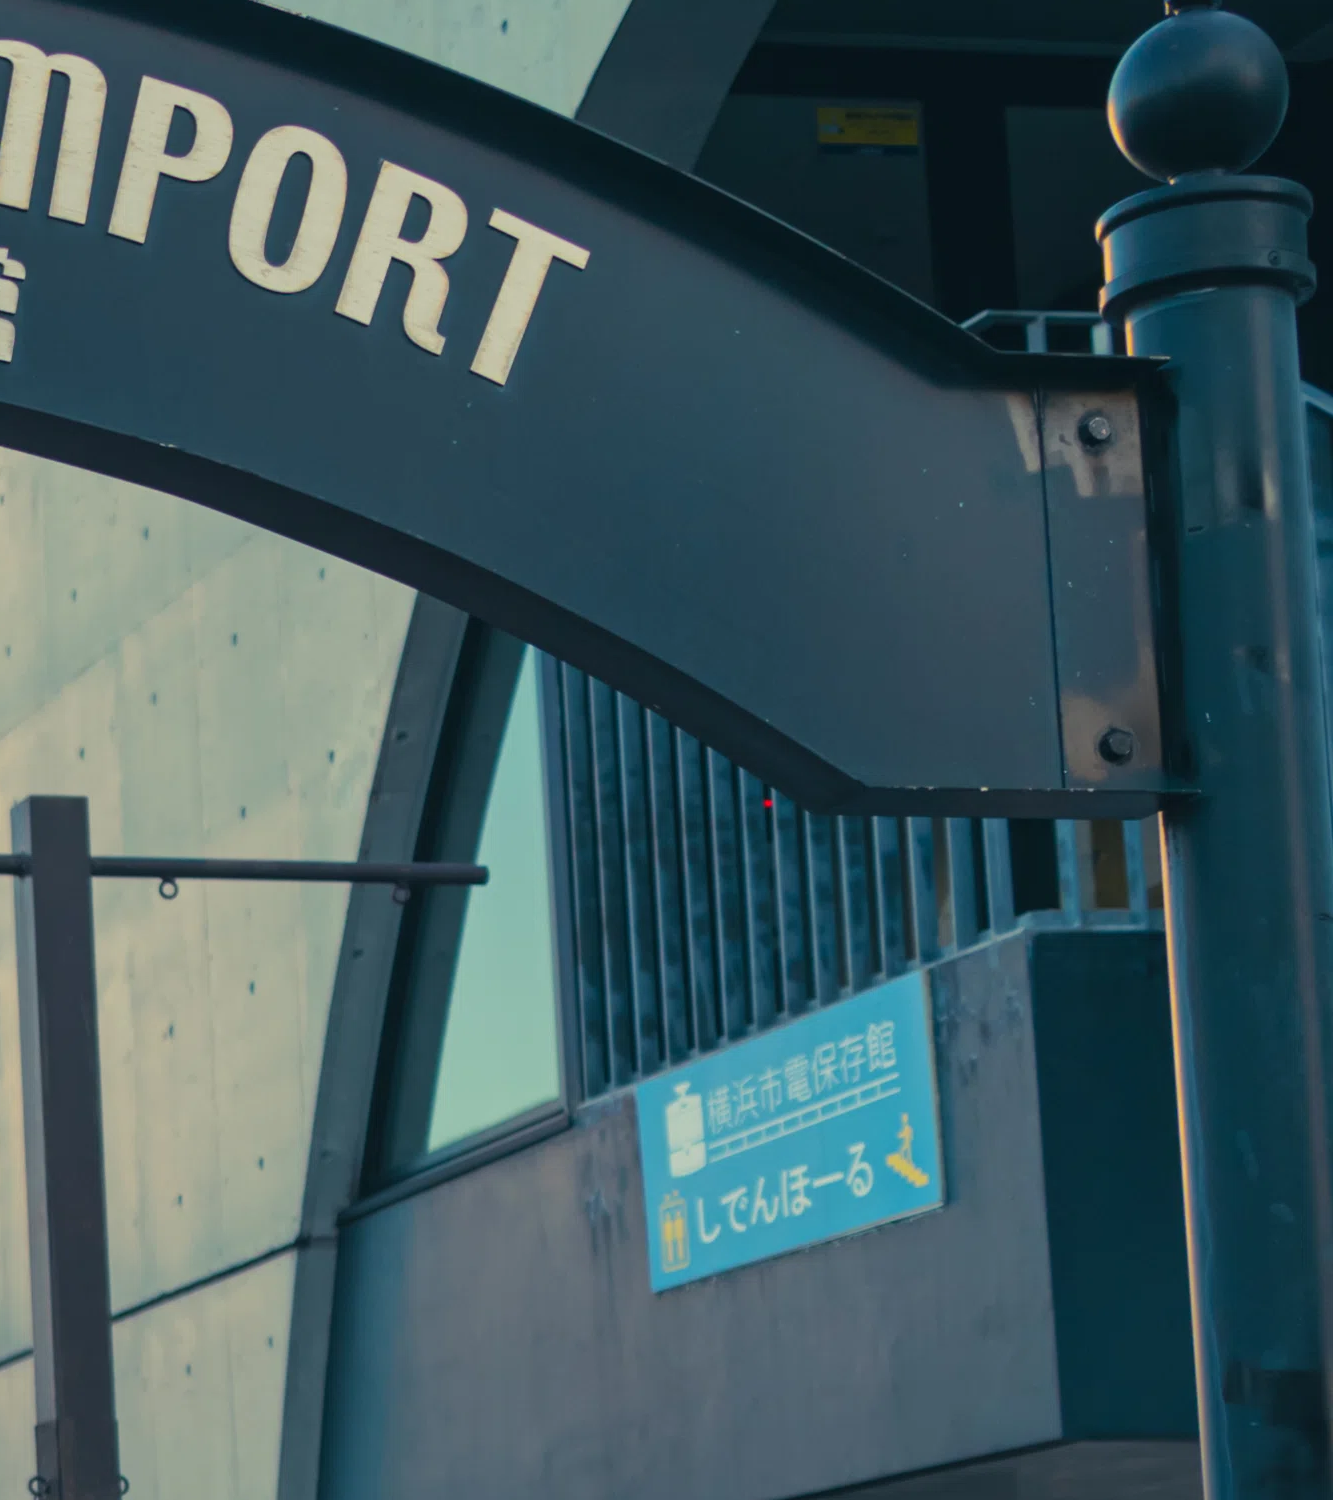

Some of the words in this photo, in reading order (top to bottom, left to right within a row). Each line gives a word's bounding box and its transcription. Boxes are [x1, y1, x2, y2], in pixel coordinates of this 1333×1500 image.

[707, 1020, 897, 1134] 横浜市電保存館
[697, 1142, 874, 1244] しでんほーる
